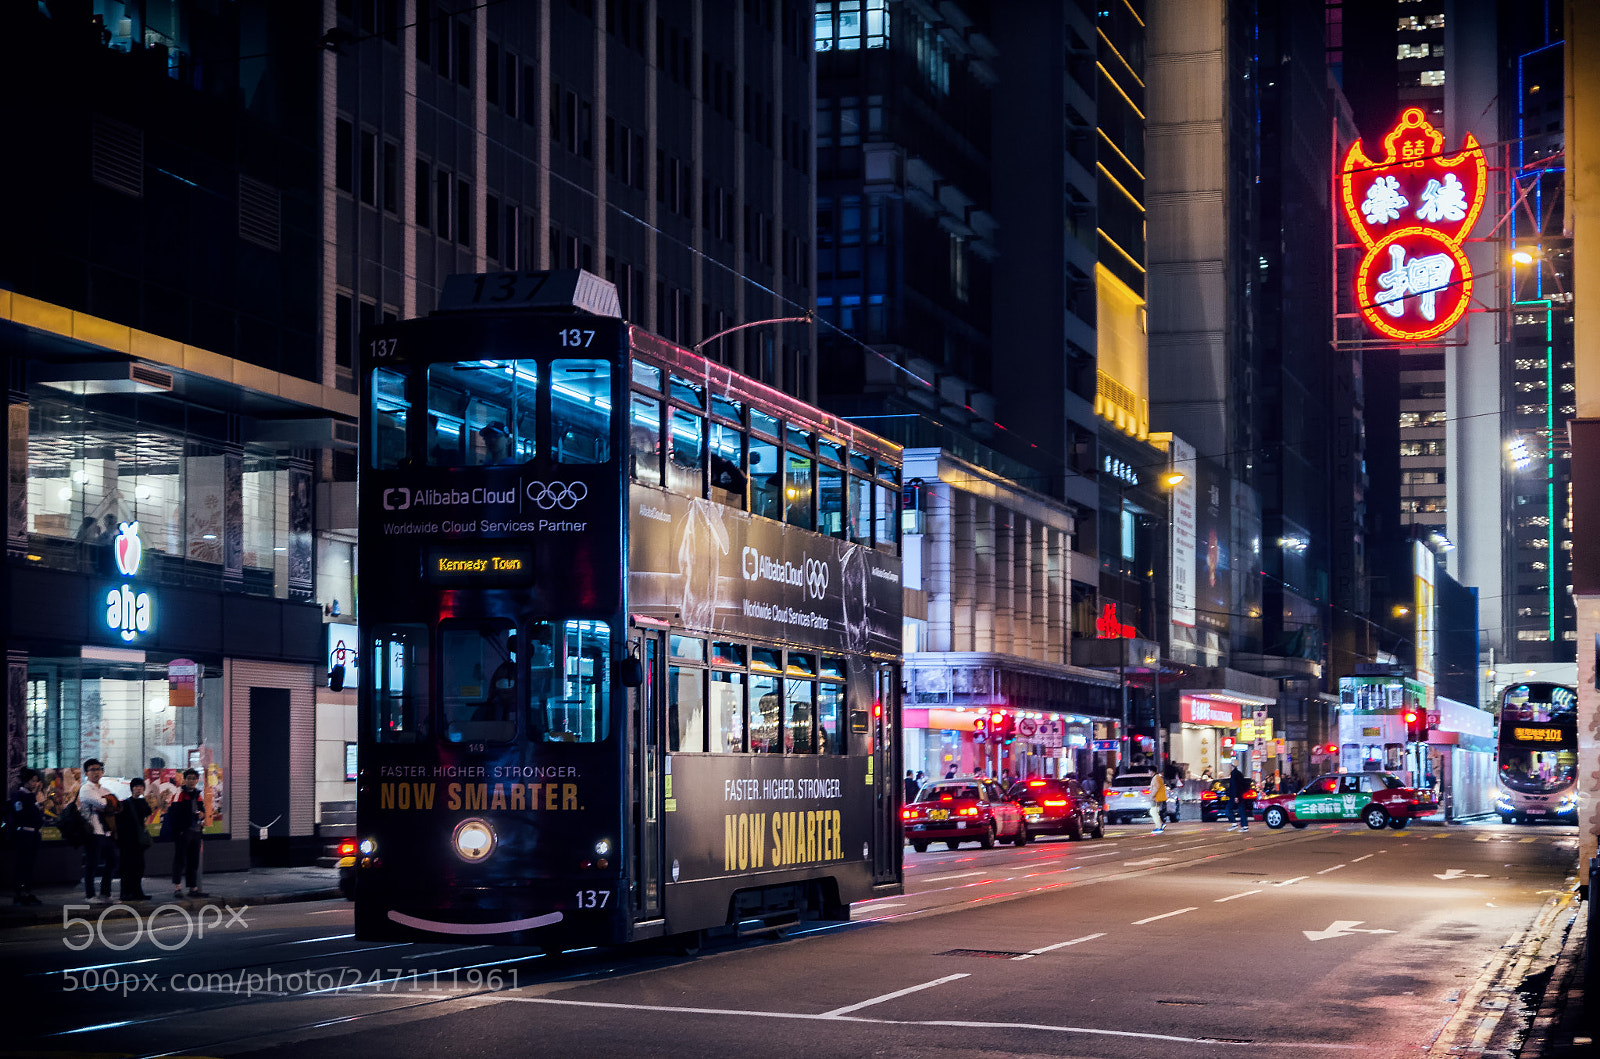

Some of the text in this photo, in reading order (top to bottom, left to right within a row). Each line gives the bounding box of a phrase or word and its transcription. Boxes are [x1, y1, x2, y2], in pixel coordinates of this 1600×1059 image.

[472, 273, 551, 303] 137
[1374, 244, 1454, 321] 押
[370, 339, 397, 357] 137
[558, 328, 596, 349] 137
[413, 486, 515, 507] Alibaba Cloud
[383, 518, 588, 535] Worldwide Cloud Services Partner
[438, 557, 522, 573] Kennedy Town
[759, 554, 803, 588] Alibaba Cloud
[106, 584, 151, 632] aha
[743, 598, 830, 631] Worldwide Cloud Services Partner
[381, 766, 582, 778] FASTER. HIGHER. STRONGER.
[381, 782, 585, 810] NOW SMARTER.
[725, 778, 843, 802] FASTER. HIGHER. STRONGER.
[724, 809, 845, 872] NOW SMARTER.
[575, 890, 611, 909] 137
